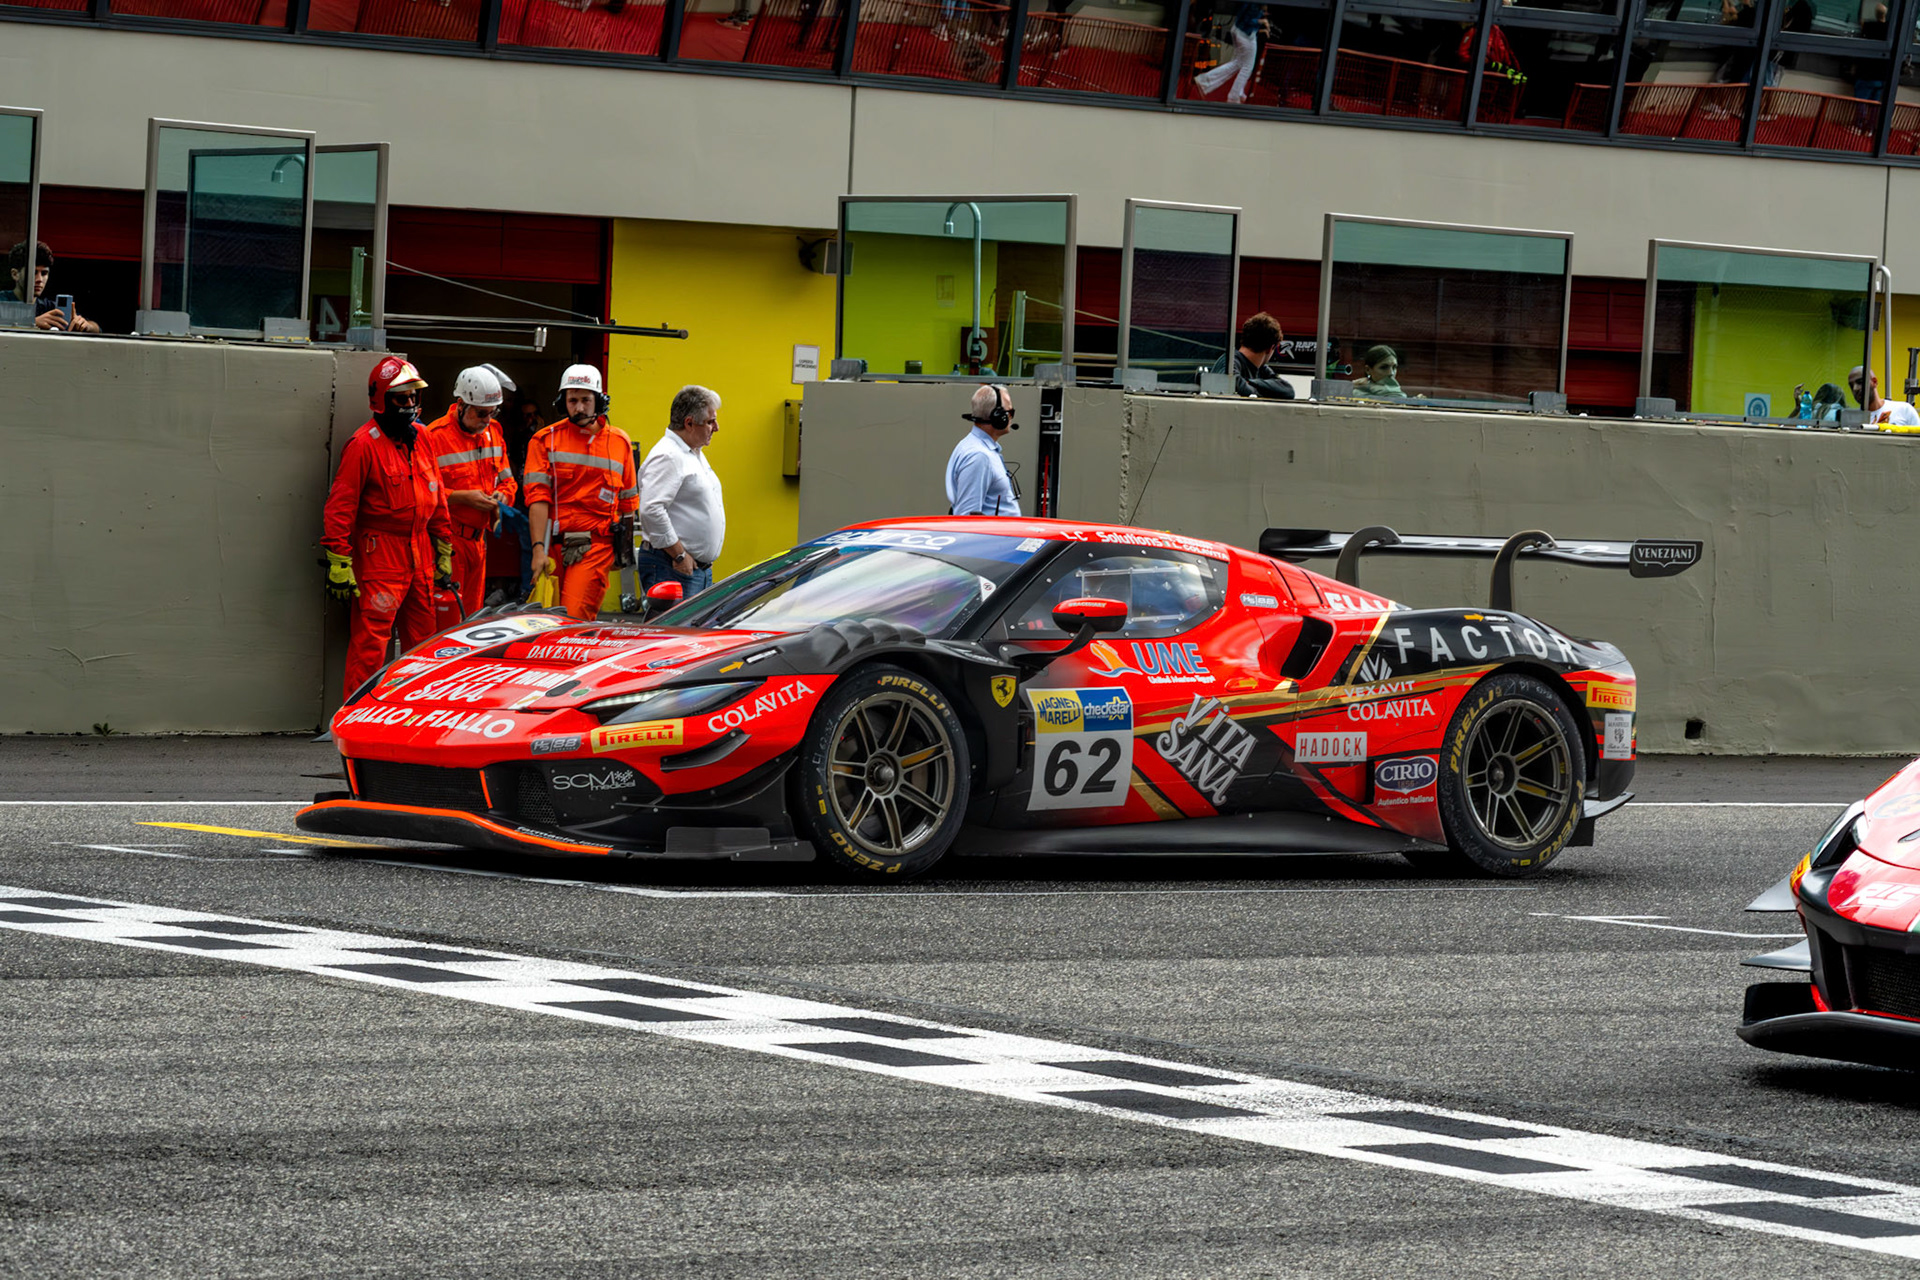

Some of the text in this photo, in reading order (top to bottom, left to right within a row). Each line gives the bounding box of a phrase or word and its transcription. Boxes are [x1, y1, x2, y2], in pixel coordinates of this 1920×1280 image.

[813, 530, 957, 550] sparco
[1095, 531, 1164, 548] Solutions
[1637, 547, 1693, 559] VENEZIANI
[525, 645, 590, 662] DAVENIA
[1393, 625, 1580, 665] FACTOR
[1130, 642, 1210, 676] UME
[443, 663, 528, 684] VITA
[403, 680, 498, 703] SANA
[879, 675, 950, 711] PIRELLI
[1343, 680, 1416, 699] VEXAVIT
[1591, 687, 1633, 707] PIRELLI
[707, 680, 816, 733] COLAVITA
[1036, 696, 1081, 714] MAGNETI
[1083, 702, 1131, 716] checkstar
[1346, 698, 1436, 722] COLAVITA
[336, 706, 516, 739] FIALLO FIALLO
[1039, 707, 1081, 726] MARELLI
[599, 724, 675, 747] PIRELLI
[1182, 691, 1259, 771] VITA
[1450, 689, 1495, 773] PIRELLI
[553, 738, 577, 748] 88
[1299, 737, 1363, 758] HADOCK
[1044, 738, 1123, 797] 62
[1155, 716, 1241, 807] SANA
[1379, 762, 1433, 782] CIRIO
[552, 770, 616, 790] SCM
[591, 779, 636, 791] medical
[1377, 795, 1435, 807] Autentico Italiano
[830, 832, 888, 871] ZERO
